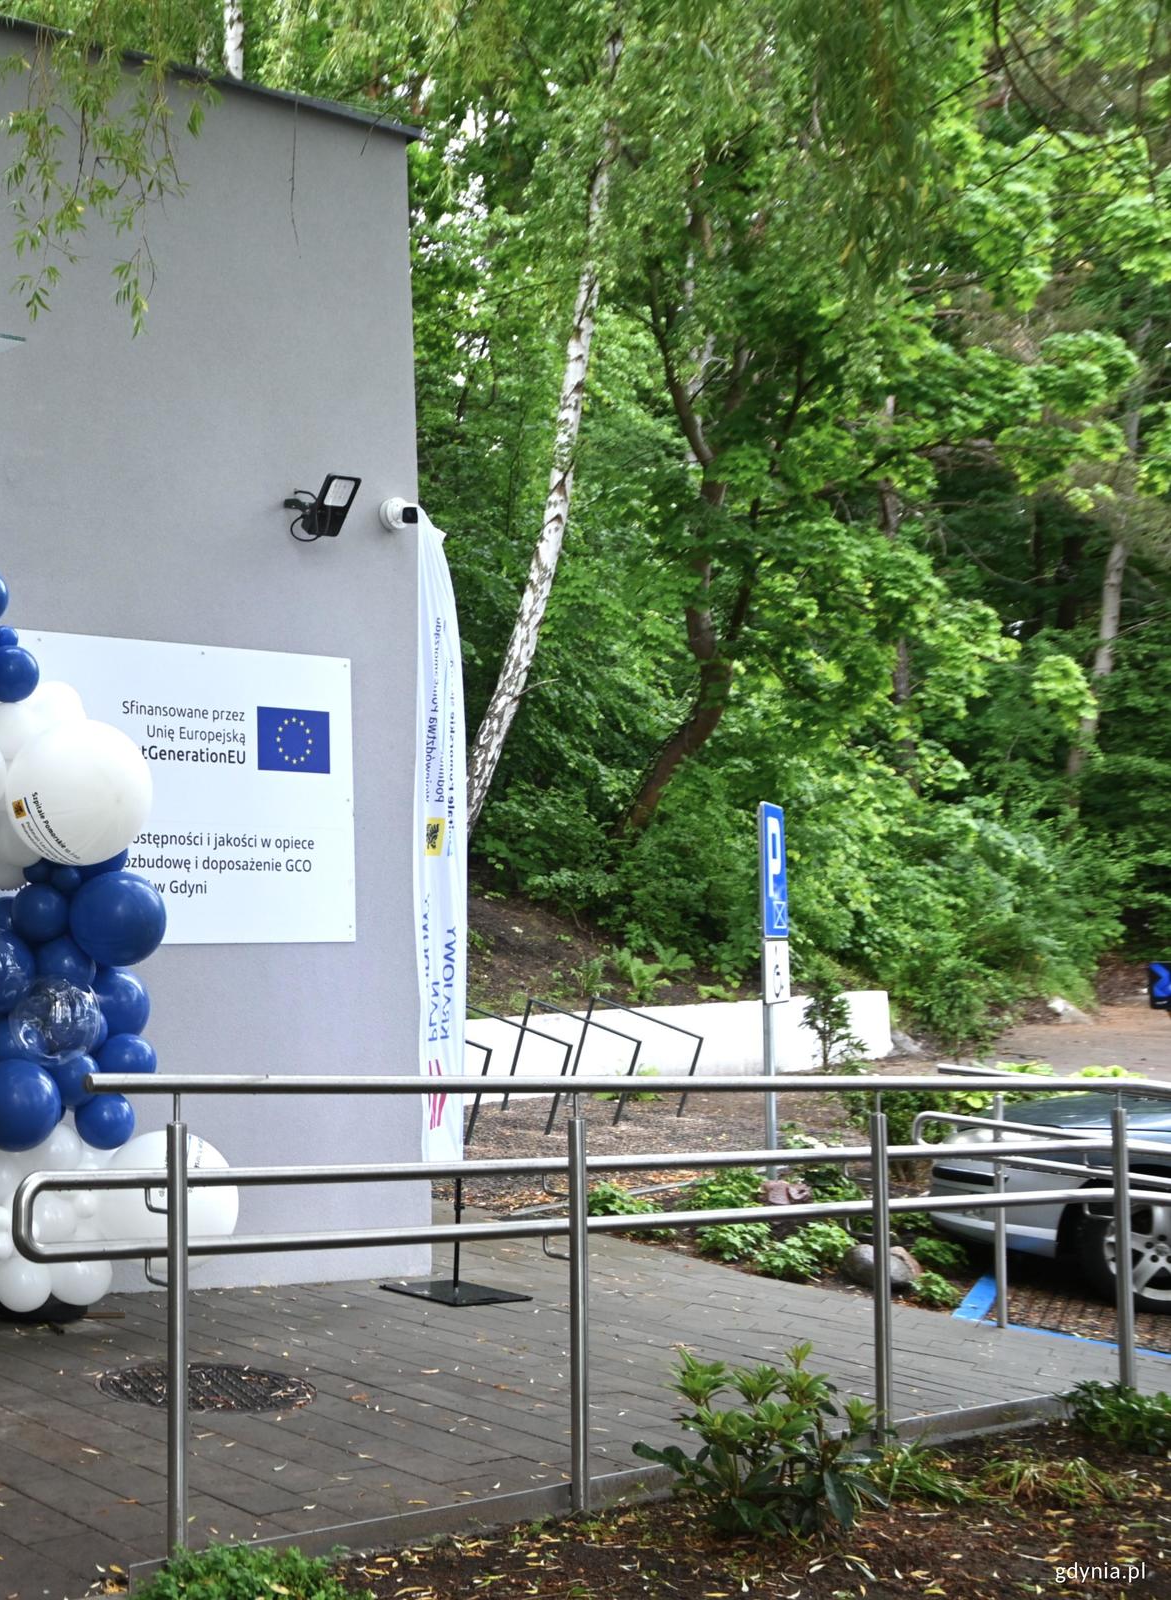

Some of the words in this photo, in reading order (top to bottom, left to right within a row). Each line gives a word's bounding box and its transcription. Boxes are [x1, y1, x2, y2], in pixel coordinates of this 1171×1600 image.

[122, 700, 209, 719] Sfinansowane
[212, 708, 246, 722] przez
[146, 725, 175, 742] Unię
[179, 726, 246, 746] Europejską
[141, 745, 246, 764] tGenerationEU
[44, 819, 66, 849] Pomorskie
[133, 831, 203, 849] ostępności
[207, 832, 210, 846] i
[213, 833, 257, 850] jakości
[261, 838, 271, 848] w
[275, 836, 315, 852] opiece
[125, 854, 191, 873] ozbudowę
[195, 856, 198, 869] i
[202, 856, 282, 874] doposażenie
[285, 859, 312, 872] GCO
[767, 816, 781, 898] P
[154, 883, 165, 893] w
[169, 880, 207, 898] Gdyni
